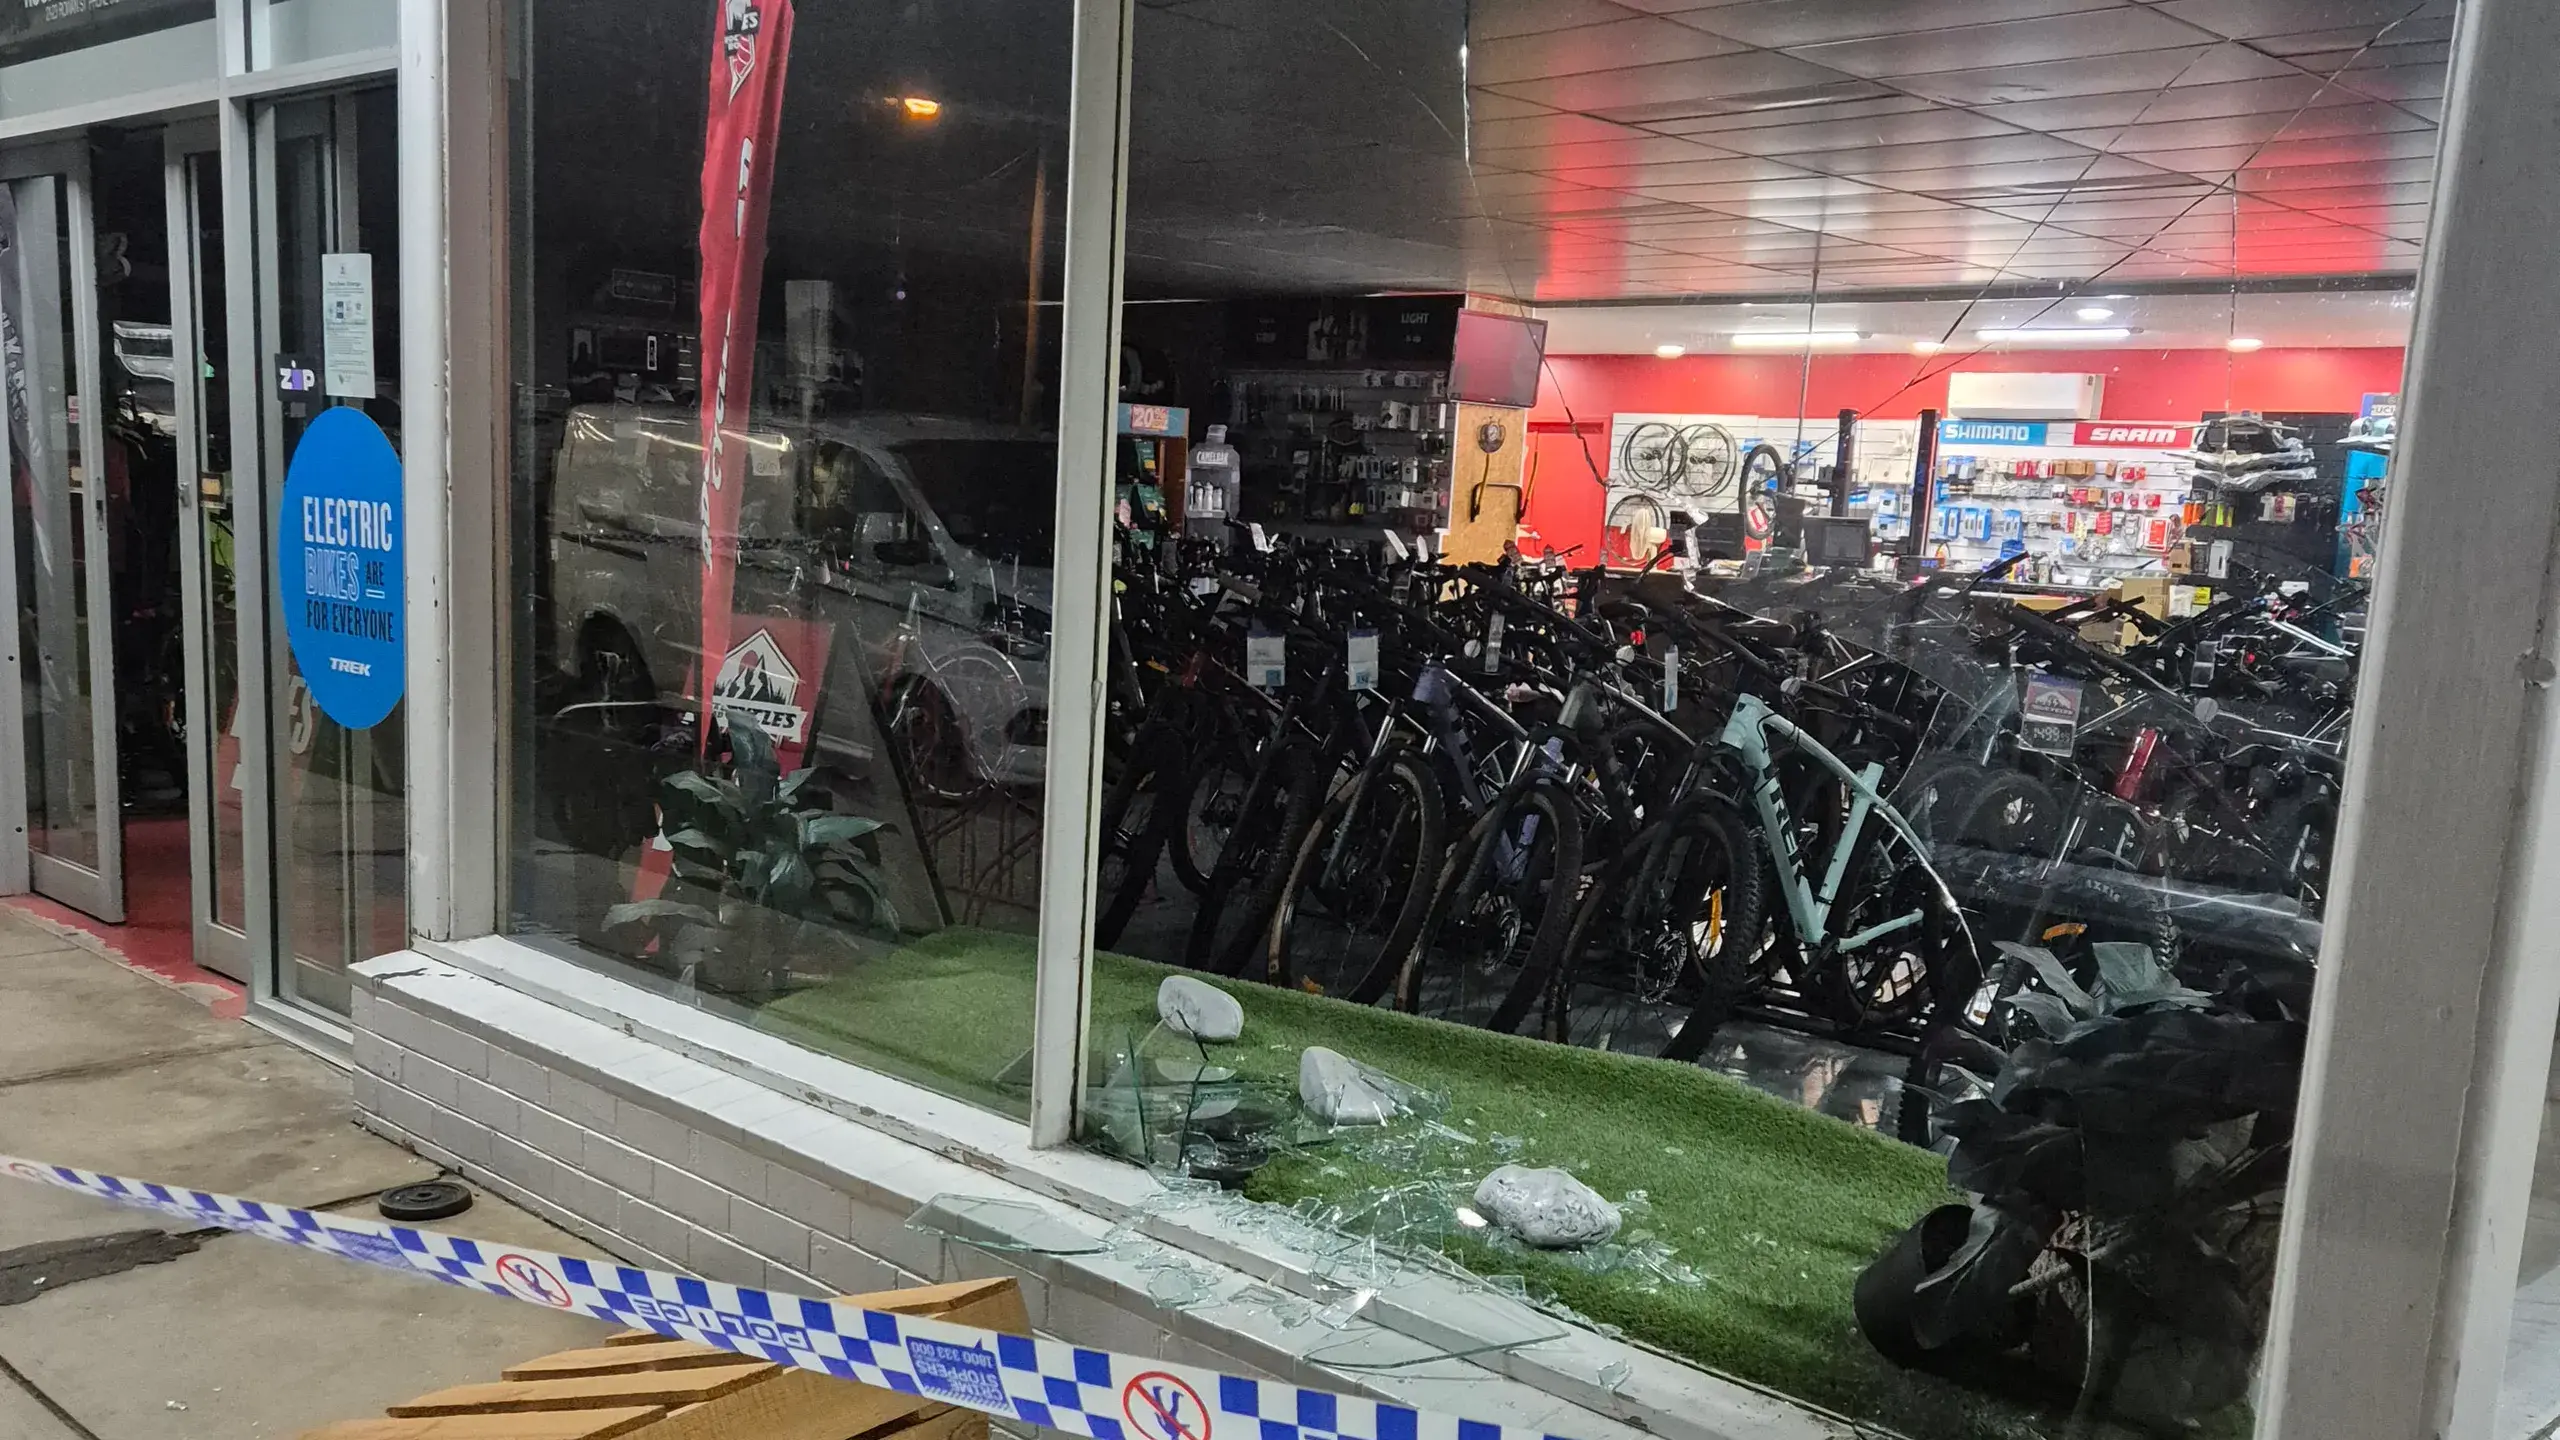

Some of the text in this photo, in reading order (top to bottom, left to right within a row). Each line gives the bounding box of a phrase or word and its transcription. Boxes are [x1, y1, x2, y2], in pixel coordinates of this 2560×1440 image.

[1945, 424, 2030, 441] SHIMANO
[2090, 427, 2177, 443] SRAM
[303, 495, 393, 552] ELECTRIC
[305, 547, 385, 602] BIKES ARE
[306, 599, 396, 643] FOR EVERYONE
[329, 657, 372, 677] TREK
[632, 1298, 808, 1351] POLICE
[911, 1341, 993, 1366] 1800 333 000
[915, 1360, 999, 1388] STOPPERS
[946, 1378, 1003, 1401] CRIME
